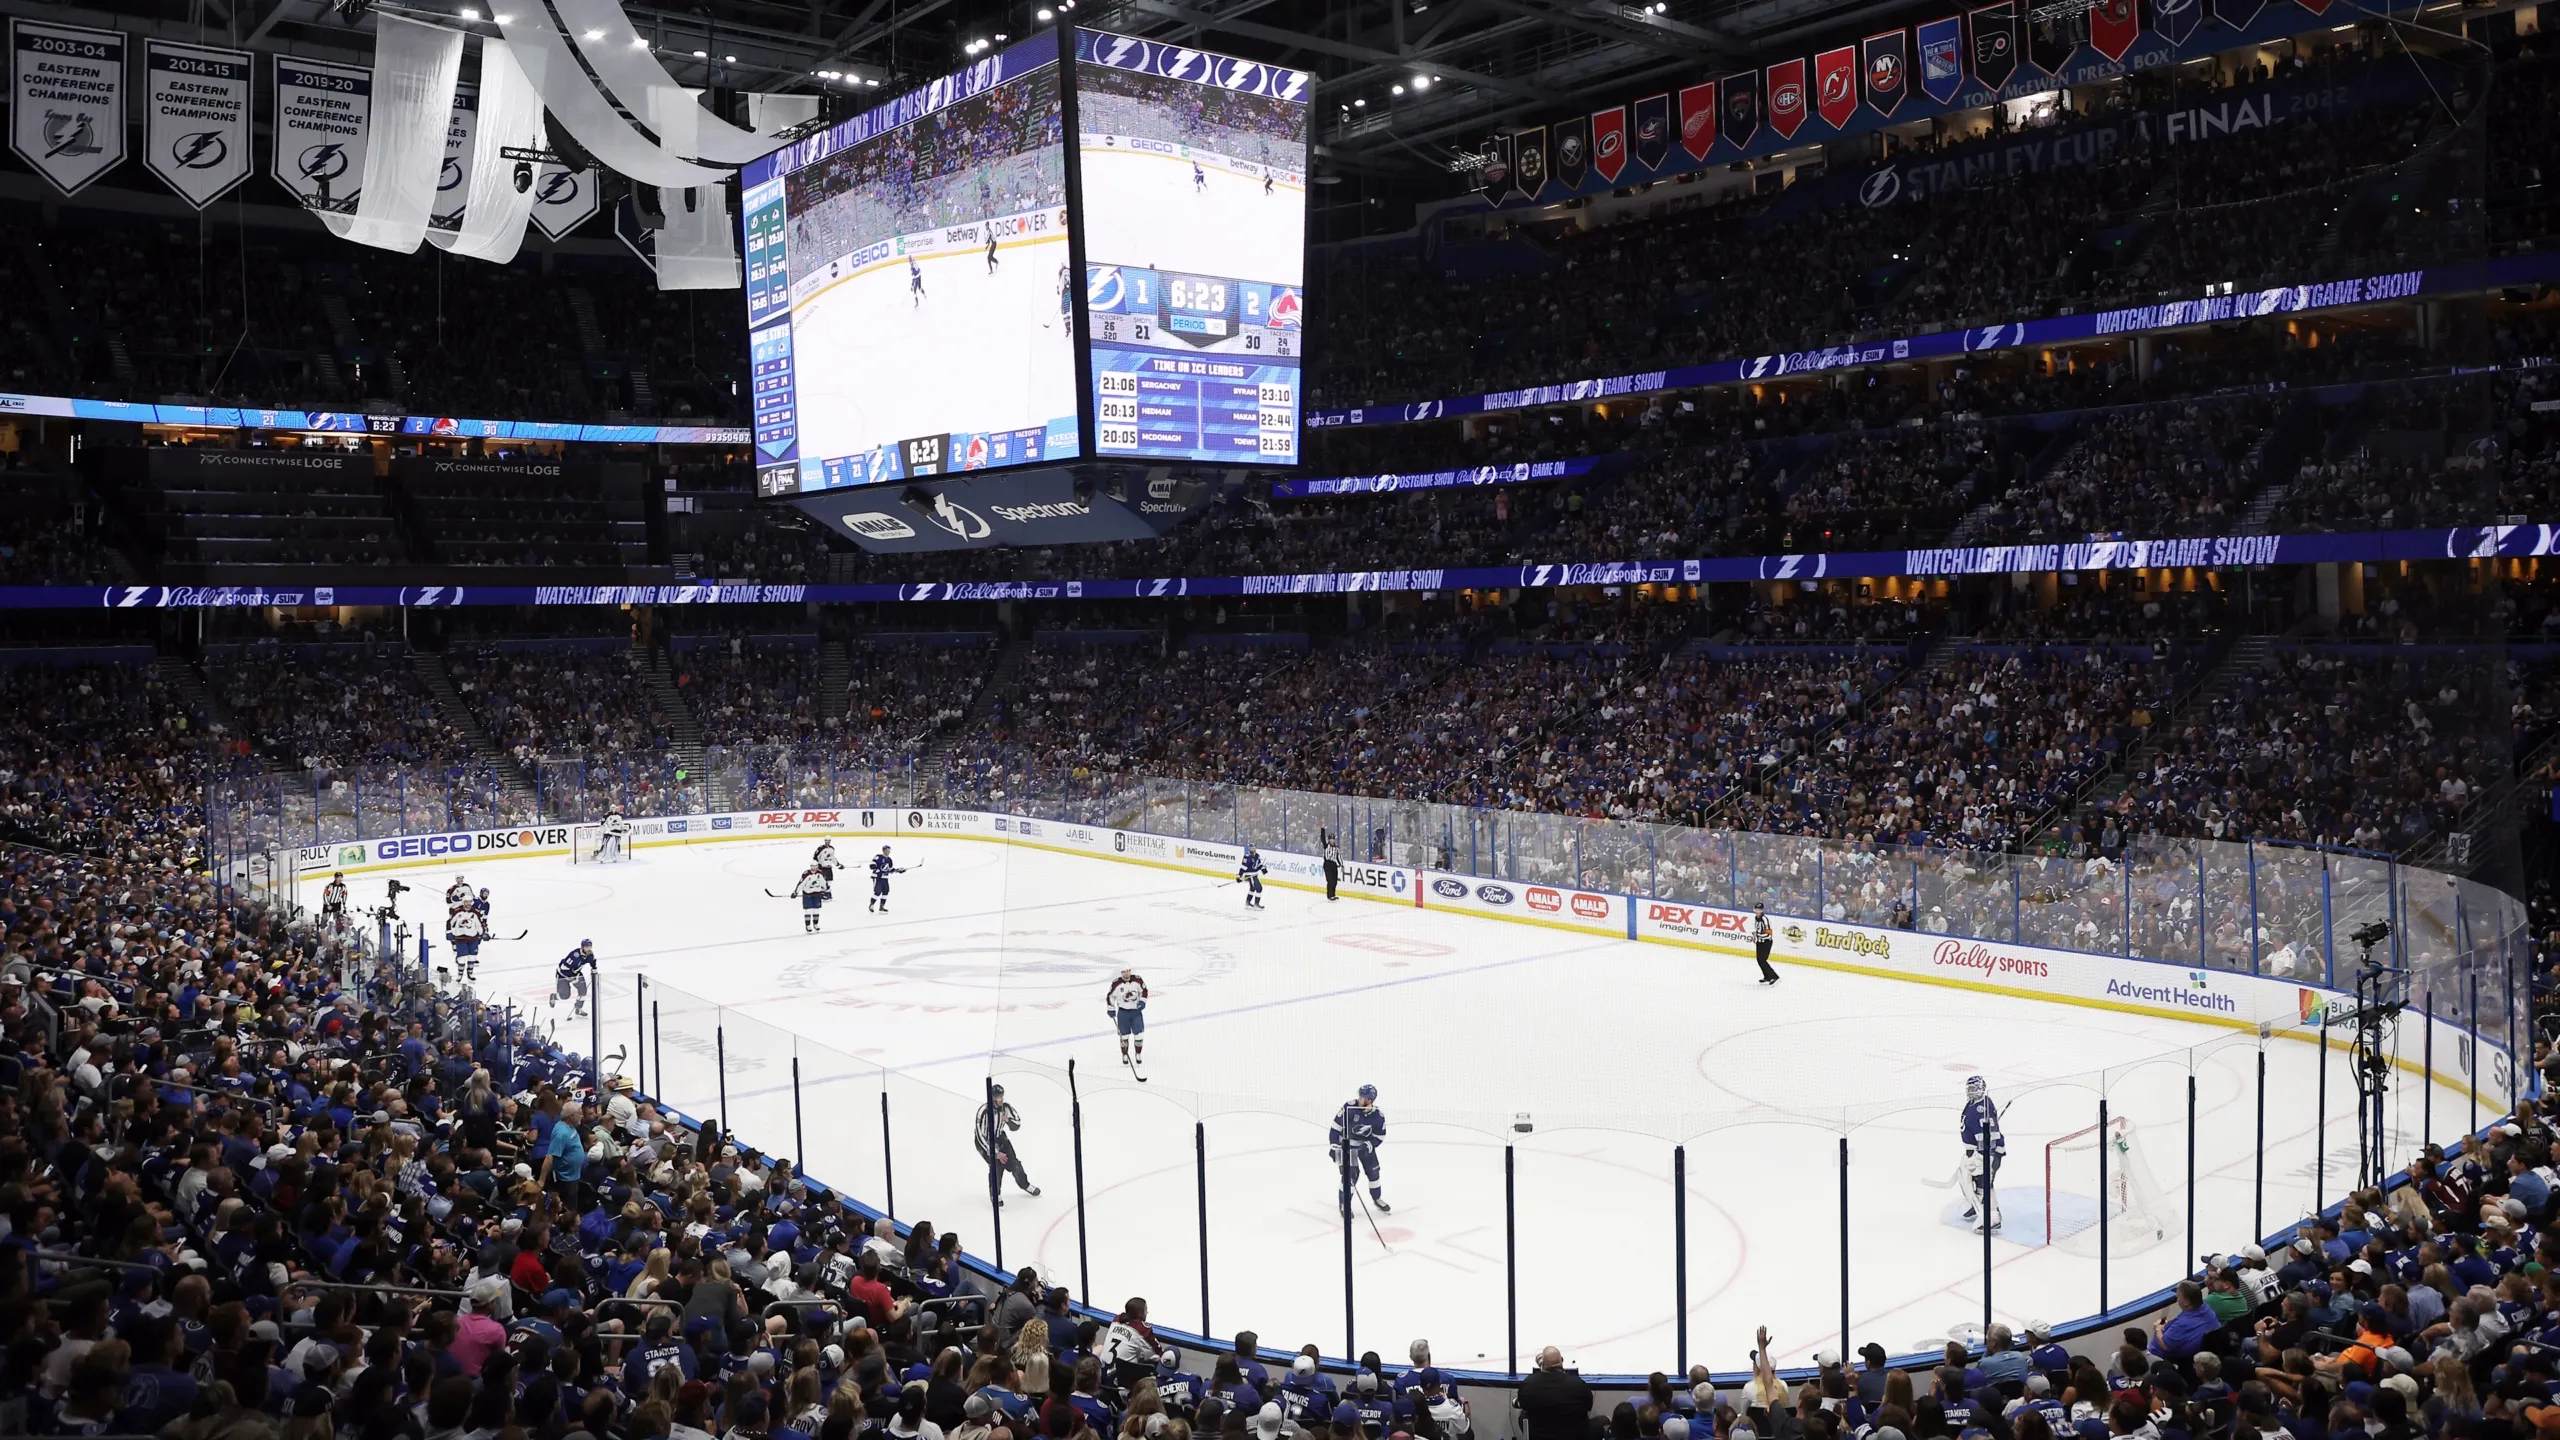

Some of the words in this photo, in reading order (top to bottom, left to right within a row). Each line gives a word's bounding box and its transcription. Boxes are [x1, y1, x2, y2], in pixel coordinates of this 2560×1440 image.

[32, 38, 106, 57] 2003-04
[38, 63, 100, 78] EASTERN
[169, 58, 230, 76] 2014-15
[23, 74, 114, 92] CONFERENCE
[295, 73, 353, 91] 2019-20
[1963, 89, 1996, 107] TOM
[2004, 71, 2070, 99] McEWEN
[2077, 60, 2125, 82] PRESS
[2134, 48, 2169, 70] BOX
[170, 81, 228, 96] EASTERN
[28, 88, 110, 105] CHAMPIONS
[156, 93, 242, 110] CONFERENCE
[297, 96, 350, 110] EASTERN
[161, 106, 237, 122] CHAMPIONS
[284, 106, 362, 124] CONFERENCE
[289, 120, 358, 136] CHAMPIONS
[2053, 128, 2117, 168] CUP
[2167, 94, 2284, 145] FINAL
[1131, 139, 1172, 153] GEICO
[1230, 158, 1258, 174] betway
[852, 243, 890, 268] GEICO
[946, 226, 978, 243] betway
[995, 213, 1047, 237] DISCOVER
[1138, 279, 1148, 304] 1
[1171, 280, 1225, 312] 6:23
[1248, 291, 1260, 315] 2
[2095, 309, 2148, 334] WATCH
[2366, 270, 2423, 300] SHOW
[1095, 314, 1123, 322] FACEOFFS
[1173, 319, 1205, 330] PERIOD
[1104, 322, 1114, 331] 26
[1136, 325, 1150, 340] 21
[1270, 330, 1295, 338] FACEOFFS
[1246, 336, 1260, 349] 30
[1278, 338, 1288, 347] 24
[1154, 360, 1175, 372] TIME
[1178, 362, 1189, 373] ON
[1192, 363, 1206, 374] ICE
[1209, 364, 1244, 377] LEADERS
[1786, 351, 1826, 373] Bally
[1827, 353, 1860, 367] SPORTS
[1865, 351, 1880, 360] SUN
[1103, 377, 1135, 391] 21:06
[1142, 381, 1181, 391] SERGACHEV
[1484, 392, 1513, 410] WATCH
[1634, 371, 1665, 392] SHOW
[1234, 388, 1256, 396] BYRAM
[1262, 389, 1290, 402] 23:10
[1103, 404, 1135, 418] 20:13
[1142, 407, 1171, 416] HEDMAN
[1233, 413, 1256, 421] MAKAR
[262, 415, 275, 426] 21
[345, 417, 351, 429] 1
[373, 421, 395, 432] 6:23
[416, 421, 423, 431] 2
[1261, 414, 1290, 427] 22:44
[484, 425, 497, 435] 30
[1016, 429, 1041, 438] FACEOFFS
[1103, 430, 1136, 444] 20:05
[1142, 433, 1181, 442] MCDONAGH
[992, 434, 1008, 442] SHOTS
[1234, 438, 1256, 446] TOEWS
[1262, 438, 1290, 451] 21:59
[890, 452, 897, 471] 1
[909, 438, 939, 464] 6:23
[954, 443, 962, 462] 2
[994, 443, 1006, 459] 30
[223, 456, 302, 466] CONNECTWISE
[304, 457, 342, 469] LOGE
[456, 464, 524, 474] CONNECTWISE
[527, 466, 560, 476] LOGE
[852, 464, 862, 478] 21
[1308, 480, 1334, 493] WATCH
[1434, 472, 1454, 485] SHOW
[1532, 463, 1550, 477] GAME
[1552, 462, 1565, 474] ON
[778, 474, 794, 485] FINAL
[991, 502, 1083, 523] Spectrum
[851, 517, 905, 534] AMALIE
[1906, 549, 1963, 575] WATCH
[1963, 545, 2057, 573] LIGHTNING
[2213, 535, 2281, 564] SHOW
[1568, 563, 1612, 585] Bally
[1613, 568, 1647, 582] SPORTS
[1654, 569, 1669, 579] SUN
[952, 581, 999, 599] Bally
[1000, 588, 1032, 598] SPORTS
[1243, 576, 1284, 595] WATCH
[1284, 574, 1335, 593] LIGHTNING
[1412, 570, 1444, 590] SHOW
[168, 586, 224, 607] Bally
[227, 593, 270, 606] SPORTS
[276, 594, 298, 604] SUN
[536, 586, 583, 605] WATCH
[584, 585, 654, 604] LIGHTNING
[763, 584, 805, 603] SHOW
[714, 820, 730, 828] TGH
[758, 813, 797, 824] DEX
[803, 812, 840, 822] DEX
[927, 814, 979, 822] LAKEWOOD
[577, 828, 592, 840] NEW
[642, 824, 663, 835] VODKA
[928, 821, 960, 829] RANCH
[1066, 829, 1094, 840] JABIL
[1127, 835, 1166, 849] HERITAGE
[377, 834, 472, 859] GEICO
[478, 829, 567, 849] DISCOVER
[301, 846, 331, 861] RULY
[1127, 847, 1166, 857] INSURANCE
[1187, 848, 1236, 861] MicroLumen
[1289, 862, 1306, 874] Blue
[1439, 880, 1464, 896] Ford
[1483, 887, 1509, 903] Ford
[1528, 892, 1559, 907] AMALIE
[1574, 899, 1606, 914] AMALIE
[1649, 905, 1694, 924] DEX
[1701, 912, 1748, 932] DEX
[1660, 920, 1699, 935] imaging
[1712, 928, 1753, 943] imaging
[1816, 928, 1850, 950] Hard
[1854, 932, 1890, 959] Rock
[1933, 940, 1998, 977] Bally
[2000, 959, 2048, 977] SPORTS
[1110, 1339, 1121, 1359] 3
[1158, 1381, 1189, 1397] UCHEROV
[1282, 1389, 1310, 1407] TAMKOS
